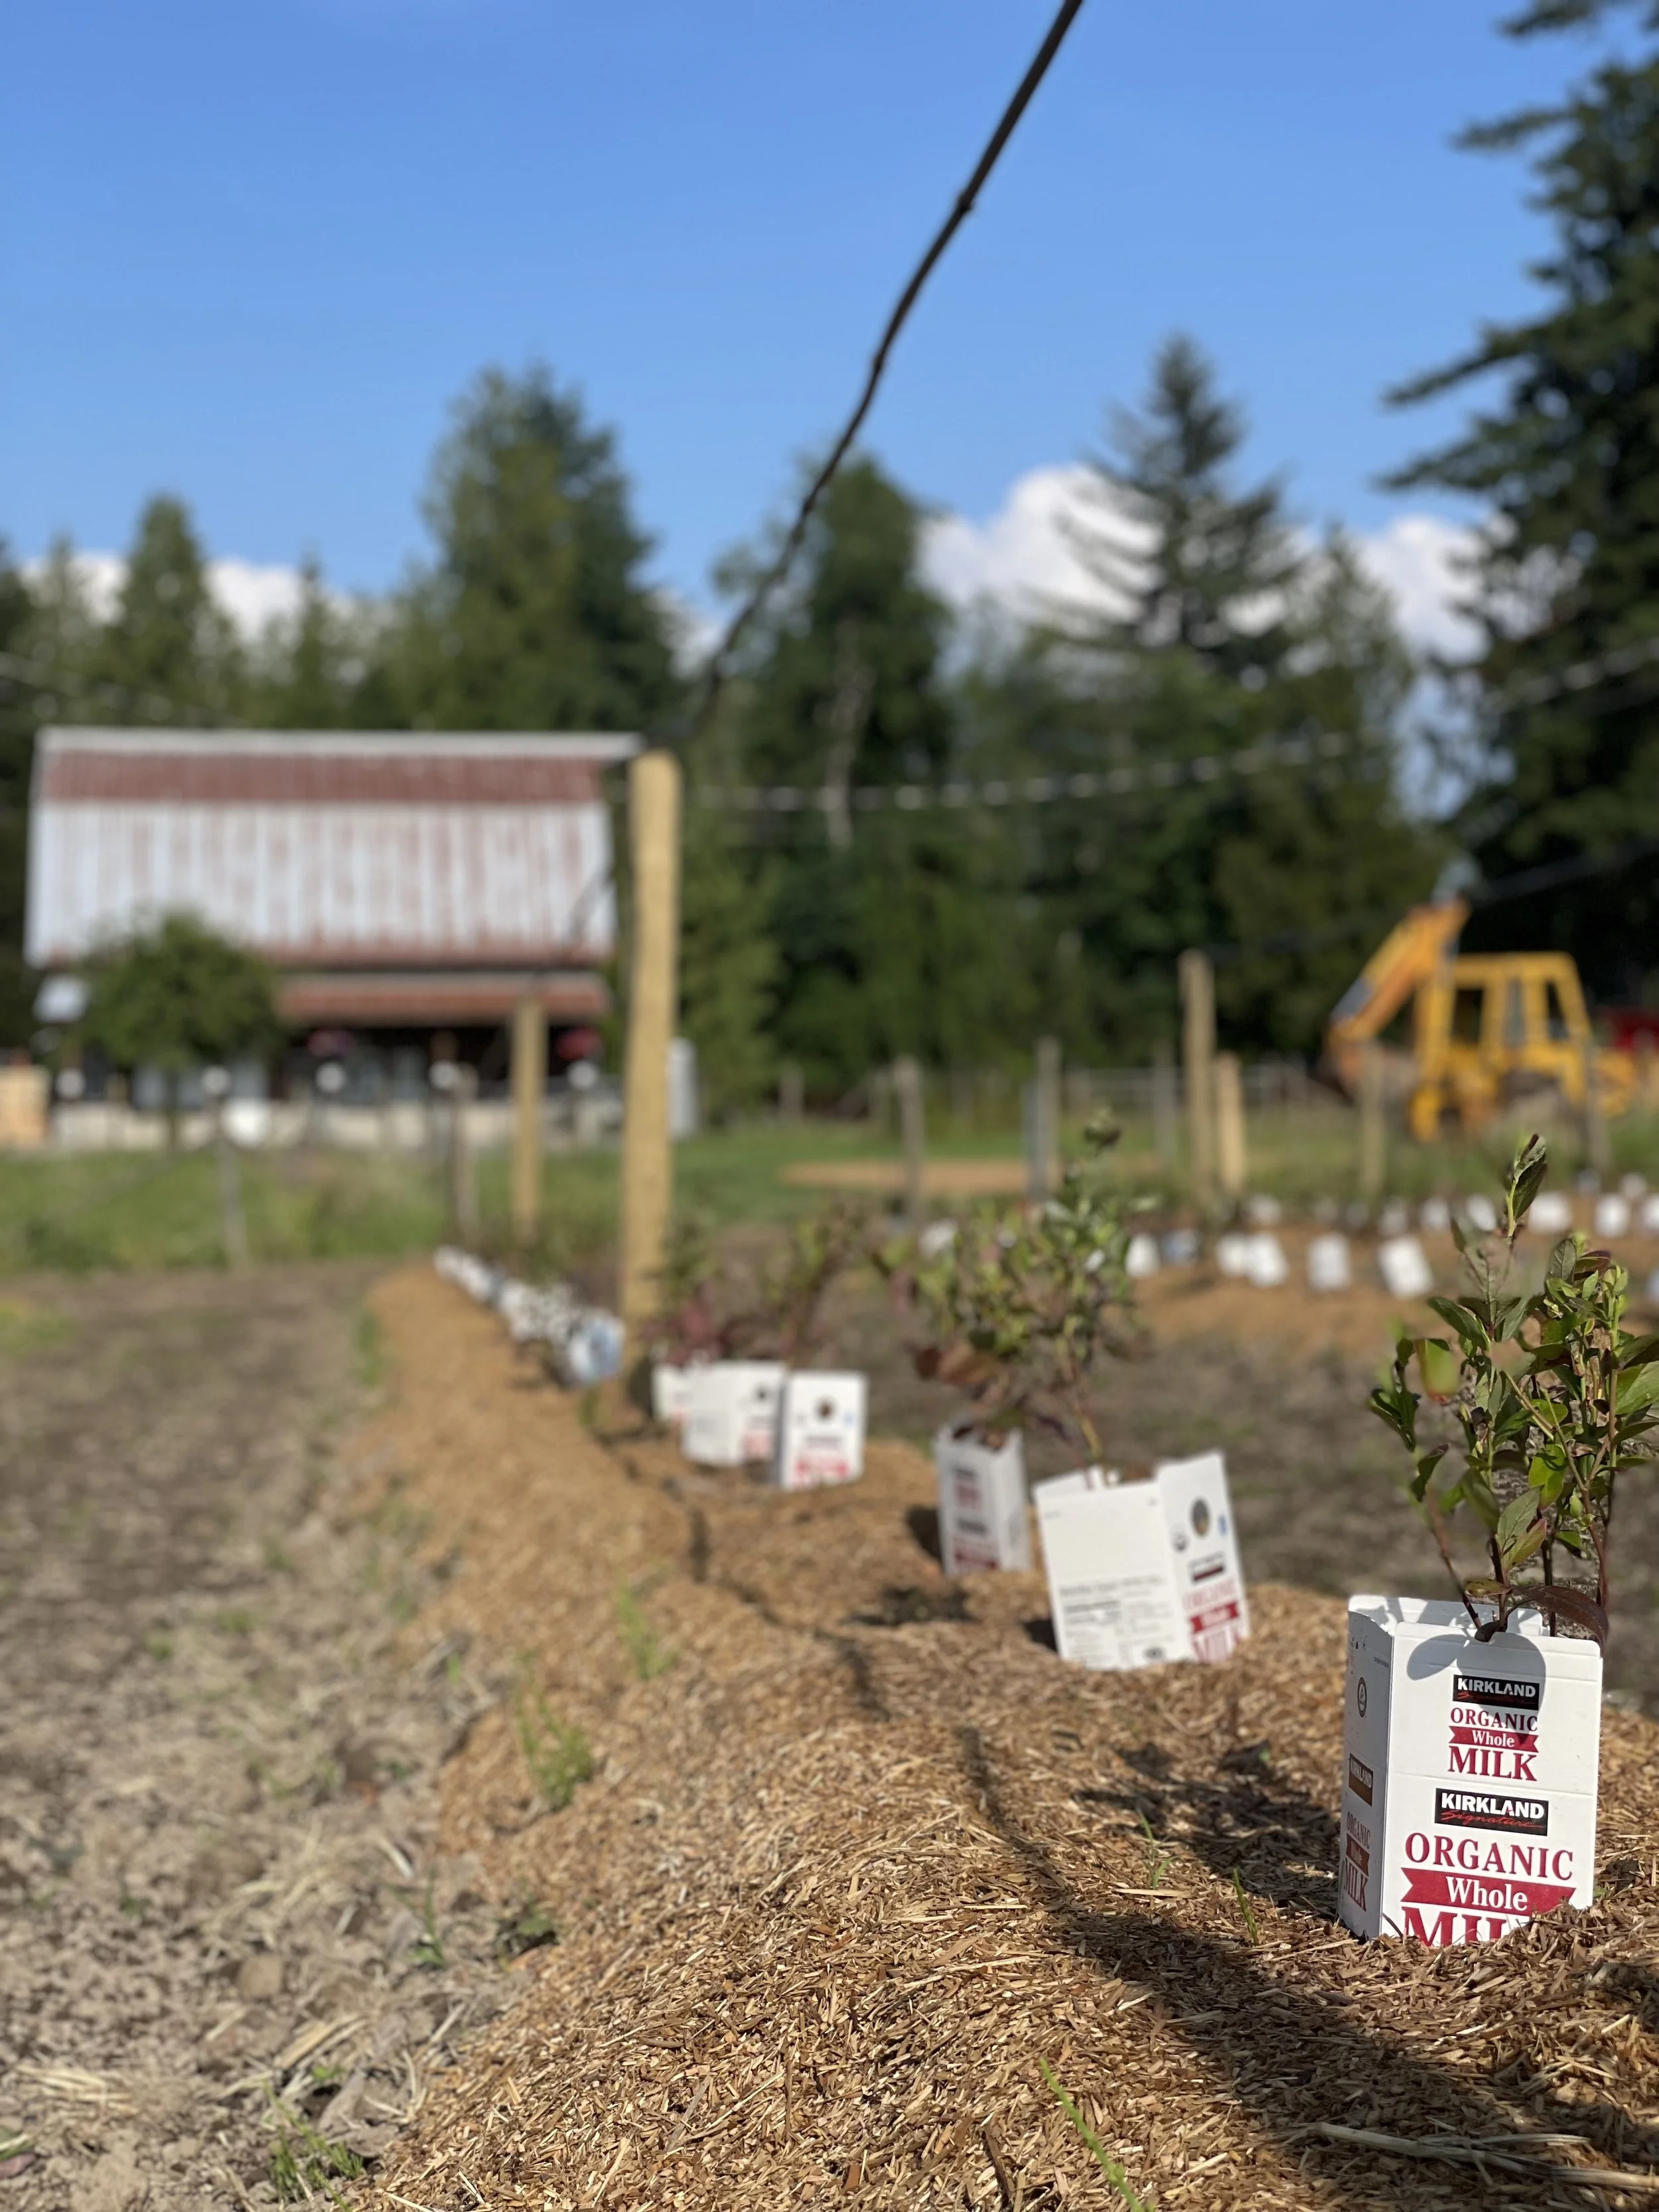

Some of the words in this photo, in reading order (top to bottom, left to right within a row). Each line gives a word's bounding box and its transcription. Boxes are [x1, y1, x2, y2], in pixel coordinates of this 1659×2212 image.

[1457, 1678, 1536, 1698] KIRKLAND
[1450, 1707, 1538, 1732] ORGANIC
[1471, 1730, 1515, 1747] Whole
[1447, 1745, 1538, 1782] MILK
[1440, 1809, 1545, 1829] Signature
[1441, 1792, 1545, 1819] KIRKLAND
[1405, 1832, 1573, 1881] ORGANIC
[1445, 1876, 1528, 1911] Whole
[1401, 1906, 1508, 1947] MI
